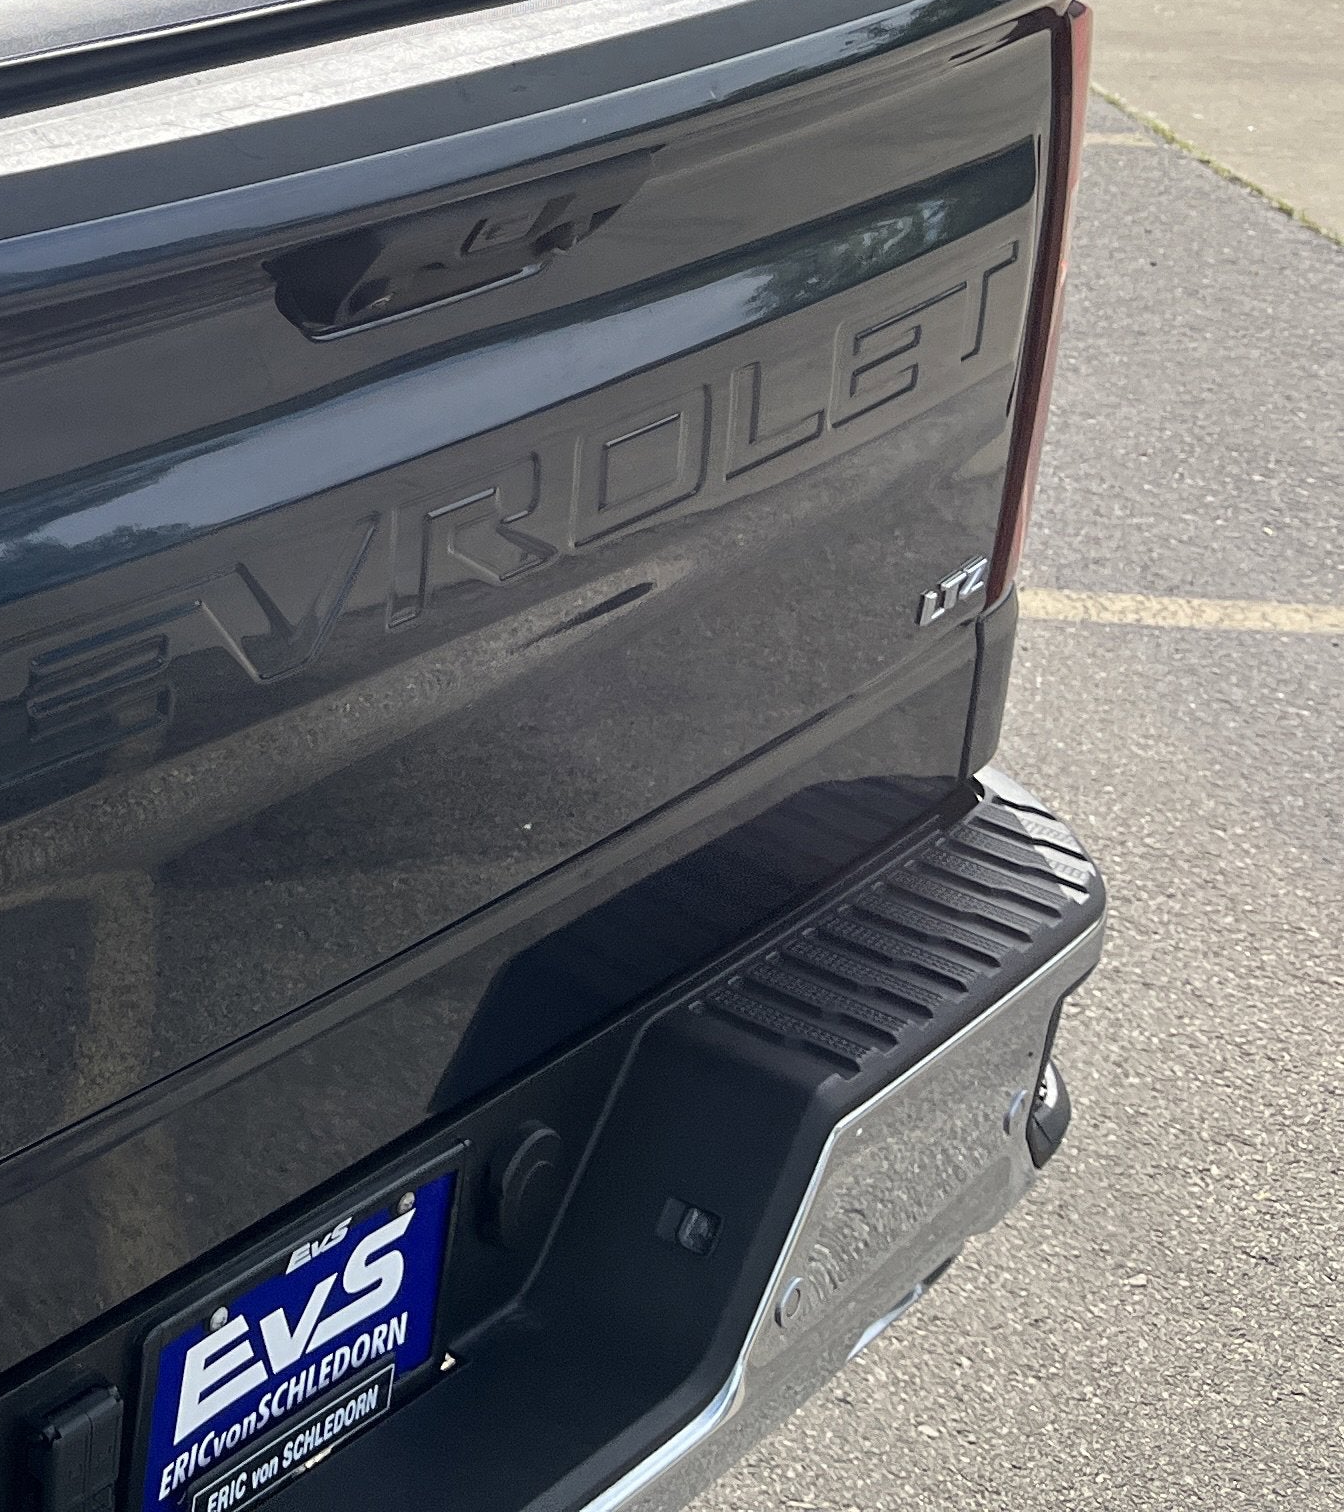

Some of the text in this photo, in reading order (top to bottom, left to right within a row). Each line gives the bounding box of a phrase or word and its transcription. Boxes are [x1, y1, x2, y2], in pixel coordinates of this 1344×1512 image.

[914, 555, 988, 627] LTZ
[207, 1384, 379, 1512] ERIC von SCHLEDORN
